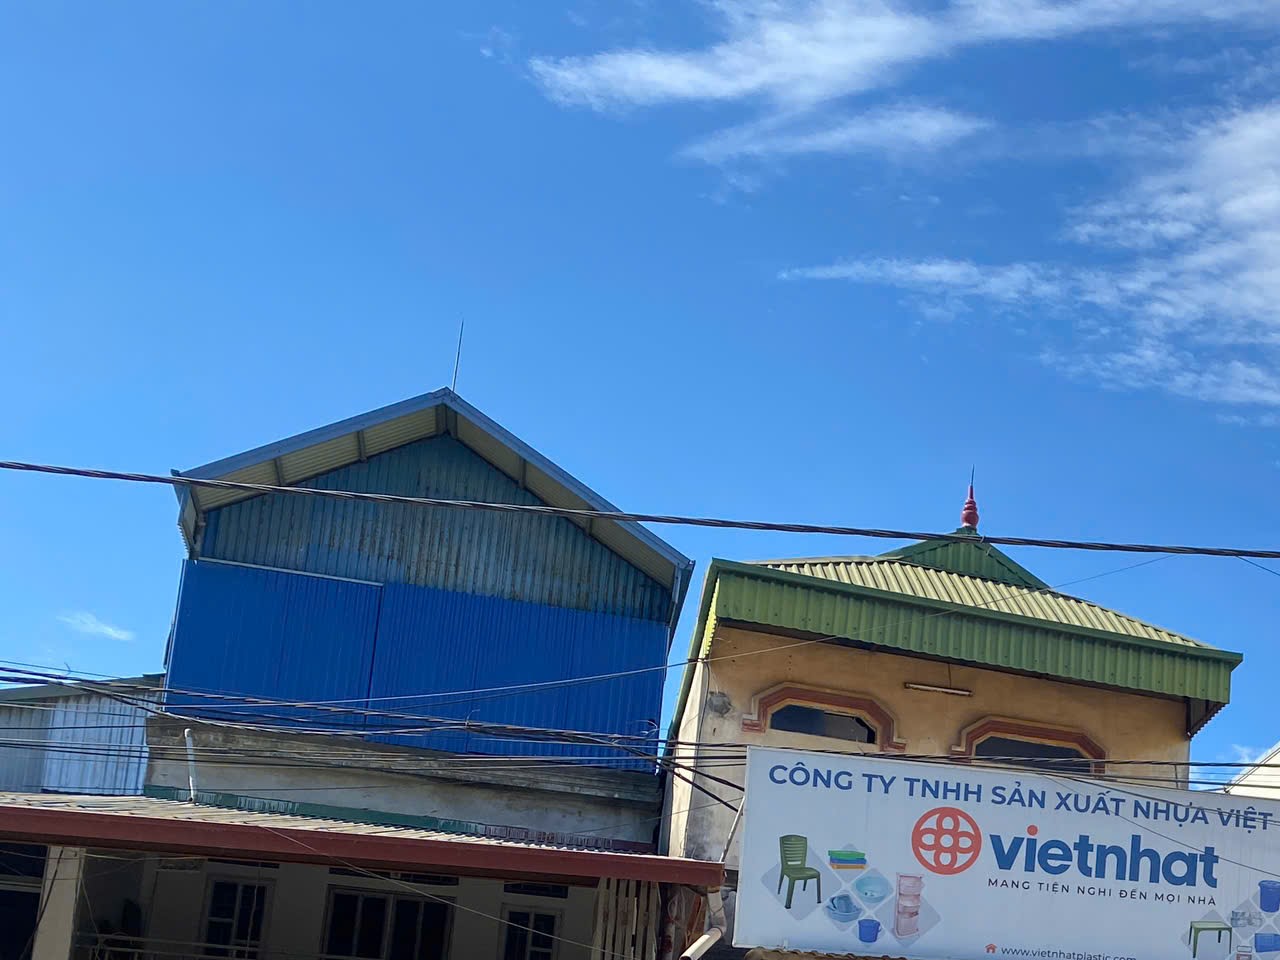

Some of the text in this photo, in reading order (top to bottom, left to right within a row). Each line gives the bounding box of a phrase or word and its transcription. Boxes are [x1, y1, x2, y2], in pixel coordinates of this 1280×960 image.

[768, 762, 853, 791] CÔNG
[862, 773, 896, 794] TY
[904, 777, 982, 803] TNHH
[990, 781, 1046, 809] SẢN
[1054, 790, 1125, 817] XUẤT
[1133, 800, 1209, 828] NHỰA
[1216, 806, 1273, 834] VIỆT
[989, 825, 1219, 888] vietnhat
[988, 878, 1216, 906] MANG TIỆN NGHI ĐẾN MỌI NHÀ
